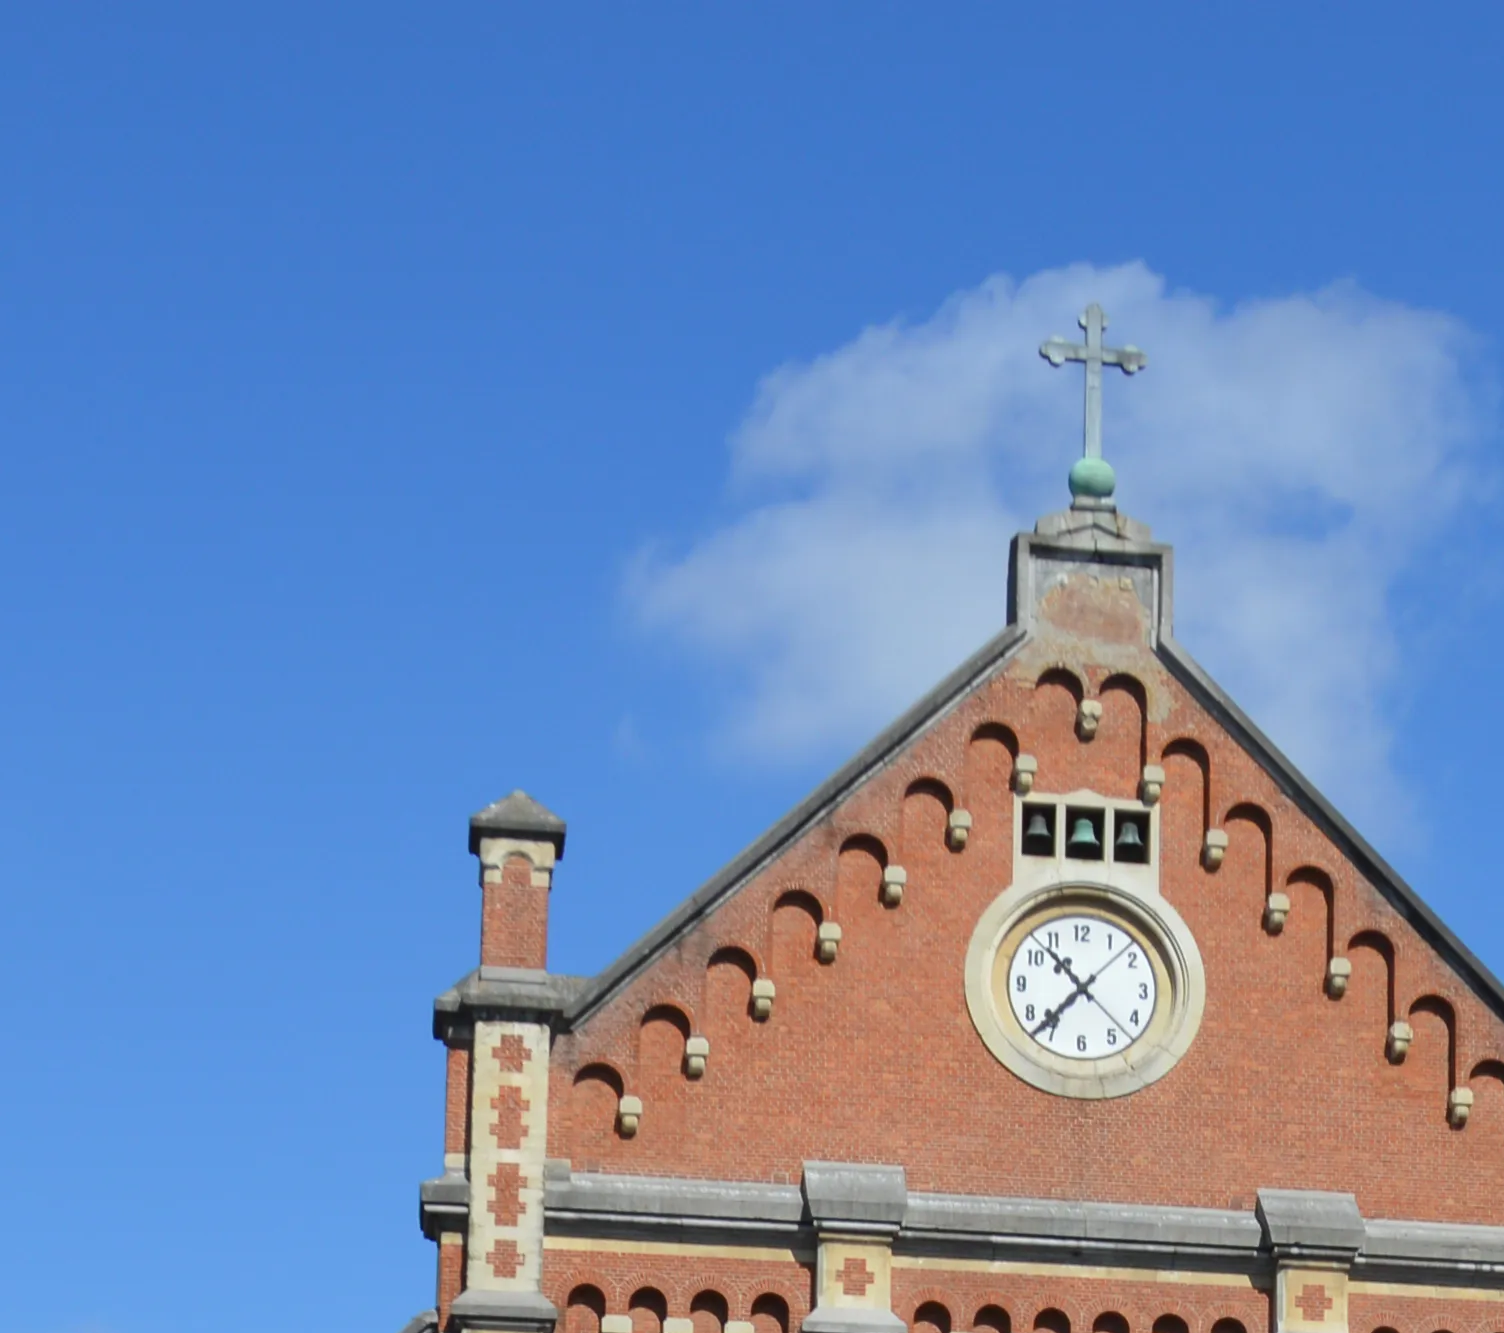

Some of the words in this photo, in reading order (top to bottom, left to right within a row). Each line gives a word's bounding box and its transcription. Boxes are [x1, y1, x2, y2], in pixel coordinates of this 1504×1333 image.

[1047, 931, 1059, 949] 11
[1074, 925, 1090, 942] 12
[1107, 933, 1112, 950] 1
[1028, 949, 1044, 966] 10
[1128, 952, 1137, 969] 2
[1016, 975, 1026, 992] 9
[1139, 983, 1148, 1000] 3
[1025, 1004, 1035, 1021] 8
[1130, 1009, 1139, 1026] 4
[1077, 1035, 1086, 1052] 6
[1107, 1028, 1116, 1045] 5
